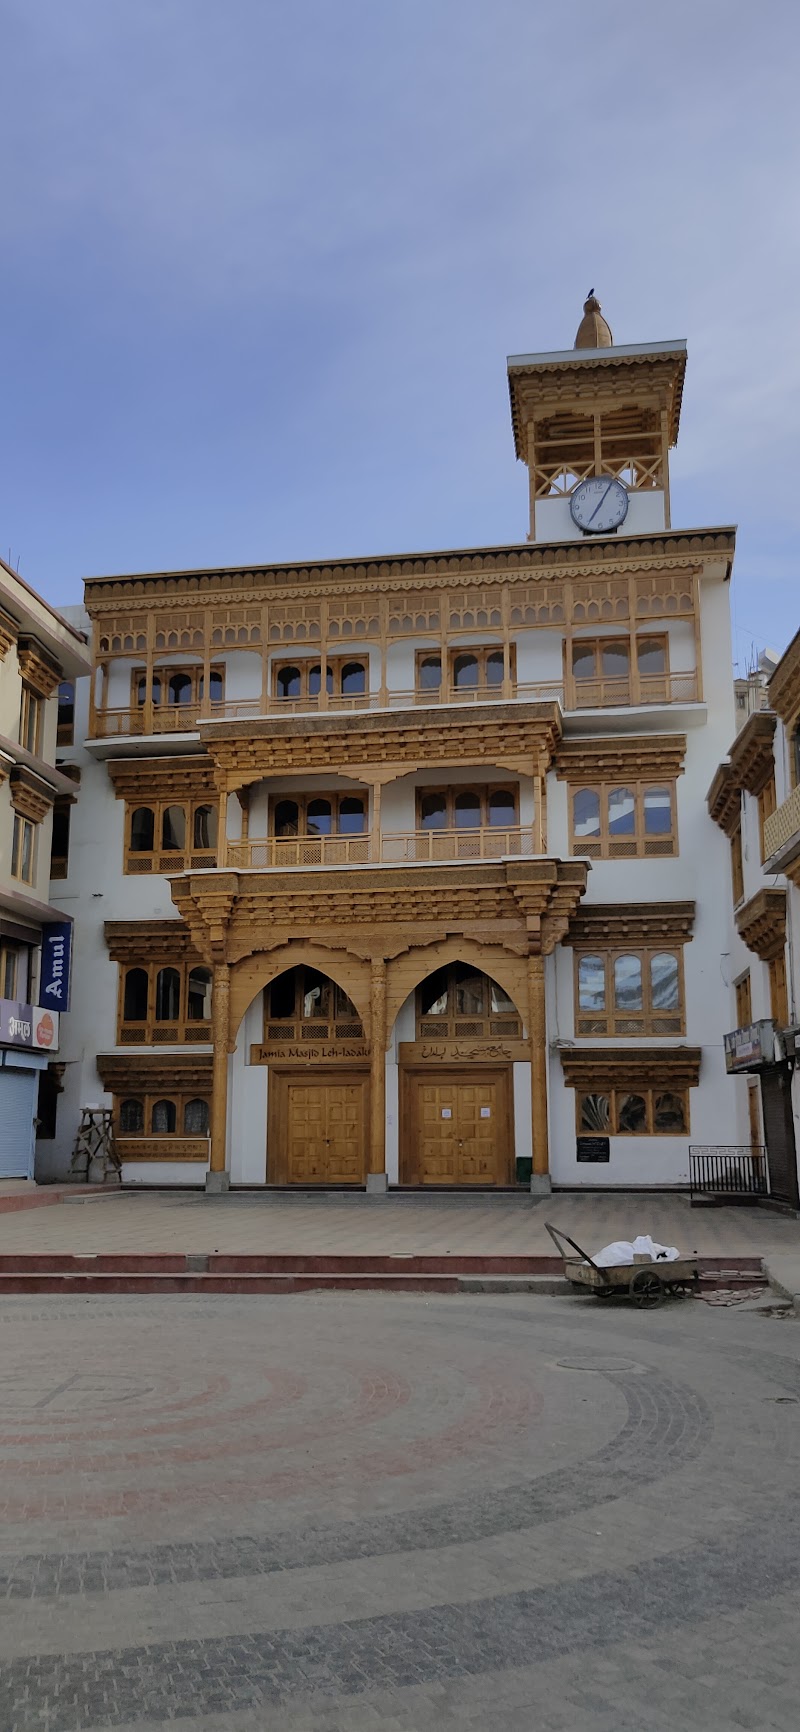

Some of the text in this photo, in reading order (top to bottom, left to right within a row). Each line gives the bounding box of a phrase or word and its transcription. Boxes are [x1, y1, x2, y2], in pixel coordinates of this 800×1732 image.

[45, 935, 65, 998] Amul
[259, 1048, 286, 1061] Jamia
[288, 1047, 320, 1059] Masjid
